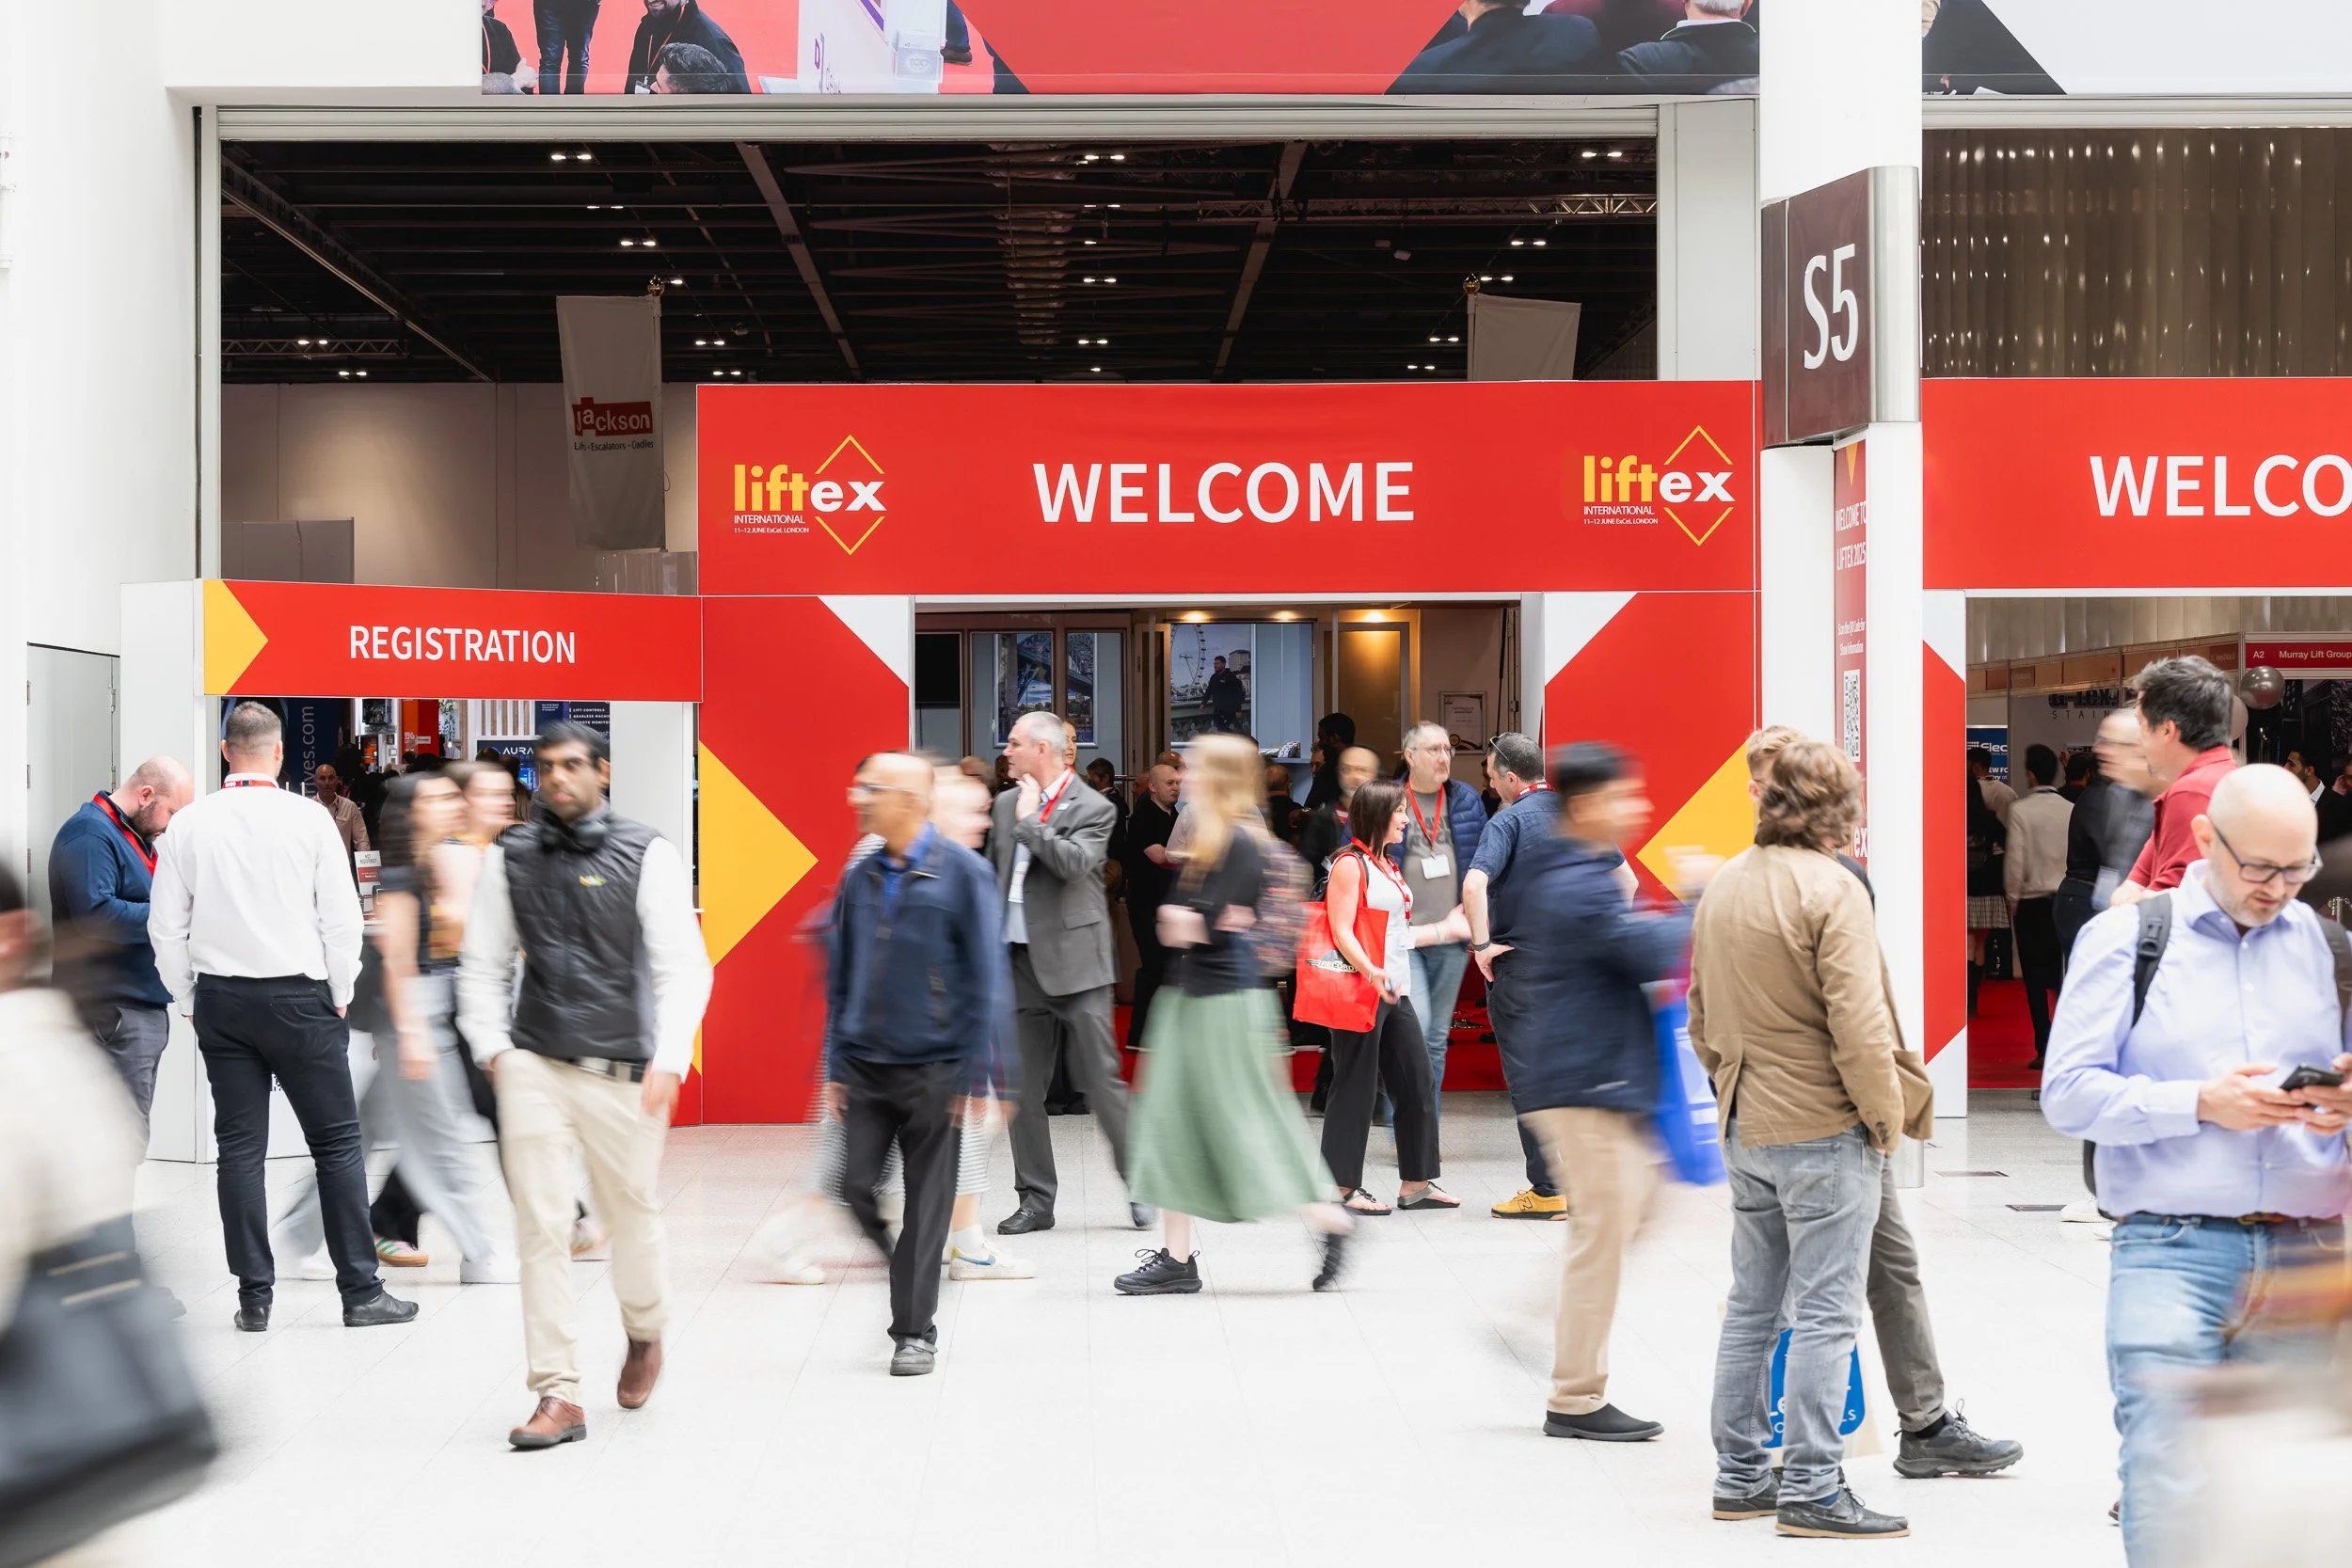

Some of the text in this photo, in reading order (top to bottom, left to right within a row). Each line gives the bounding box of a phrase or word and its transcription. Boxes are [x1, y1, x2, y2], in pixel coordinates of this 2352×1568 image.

[1804, 244, 1859, 370] S5
[734, 464, 888, 513] liftex
[1032, 462, 1415, 523] WELCOME
[1583, 455, 1737, 503] liftex
[2089, 454, 2352, 517] WELCO
[734, 515, 805, 524] INTERNATIONAL
[1583, 506, 1654, 515] INTERNATIONAL
[1836, 503, 1860, 531] WELCOME
[1836, 545, 1853, 571] LIFTEX
[350, 625, 576, 664] REGISTRATION
[2252, 650, 2352, 660] A2 Murray Lift Group
[502, 747, 534, 755] AURA
